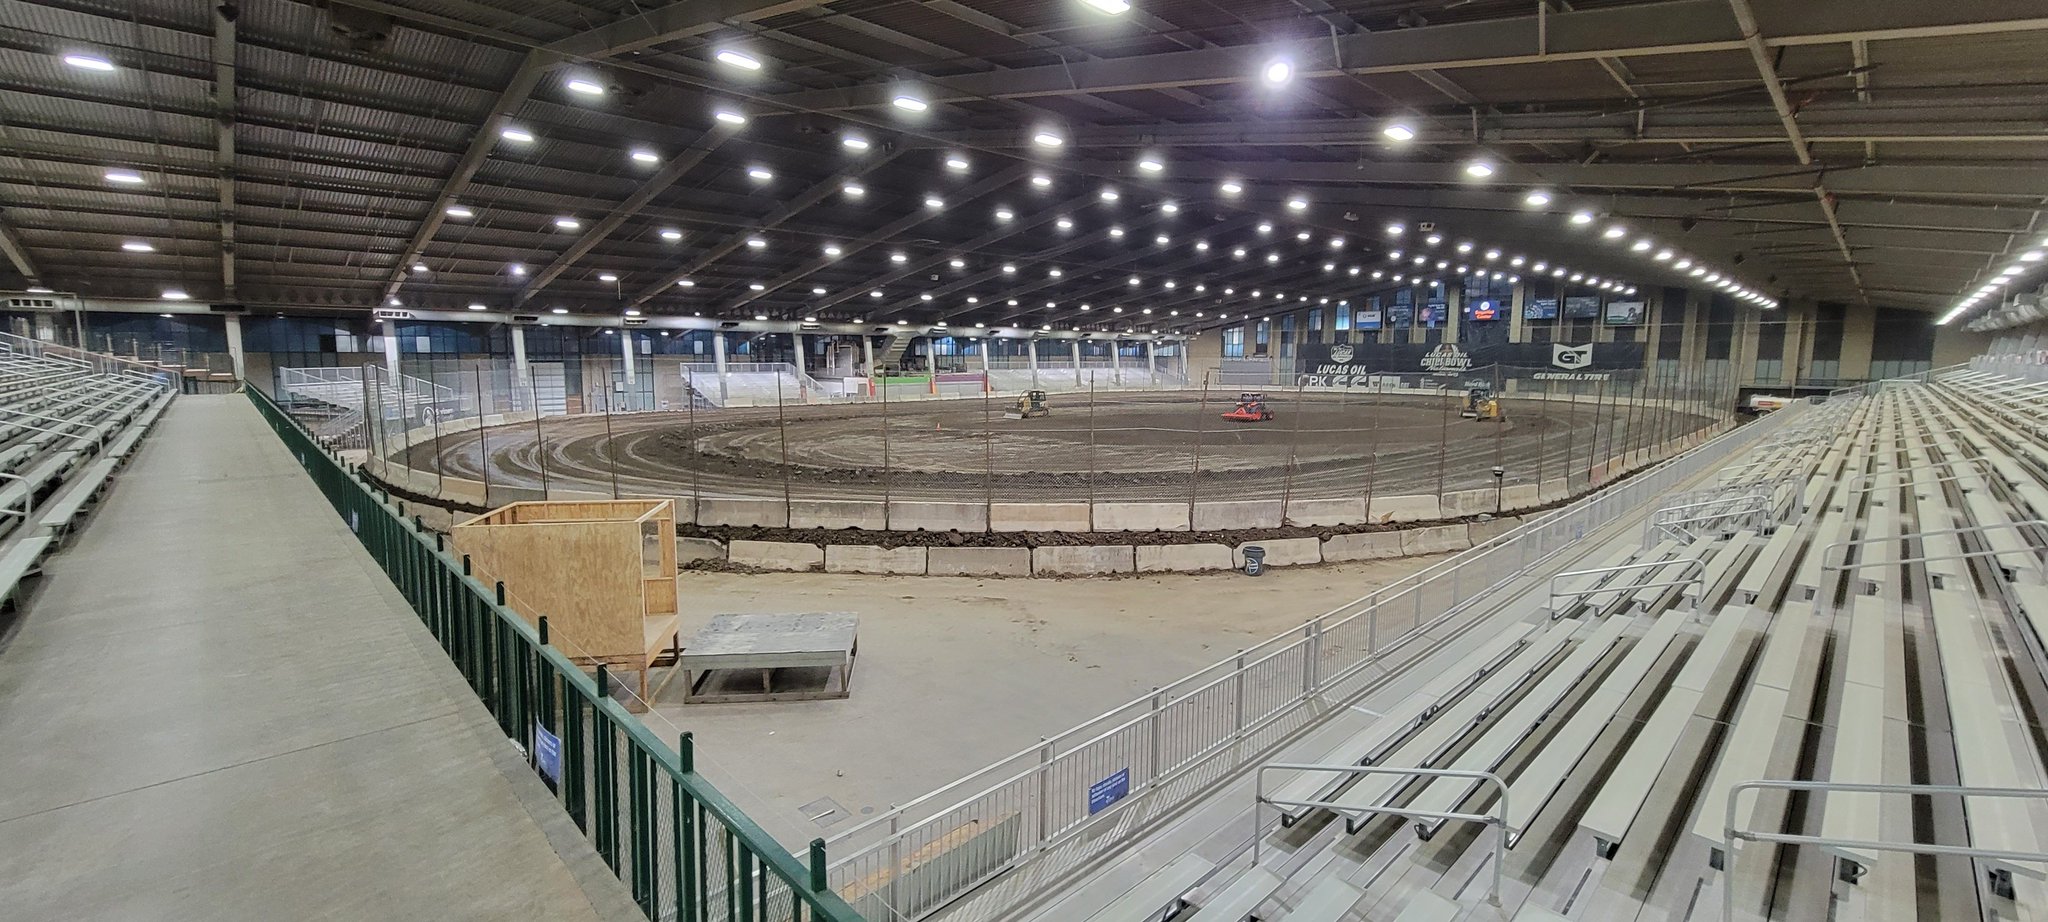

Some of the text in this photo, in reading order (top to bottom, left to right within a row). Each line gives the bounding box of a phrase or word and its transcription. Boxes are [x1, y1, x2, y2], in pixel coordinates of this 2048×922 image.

[1557, 350, 1588, 364] GT
[1444, 358, 1473, 367] BOWL
[1316, 364, 1367, 375] LUCAS OIL
[1533, 372, 1582, 380] GENERAL
